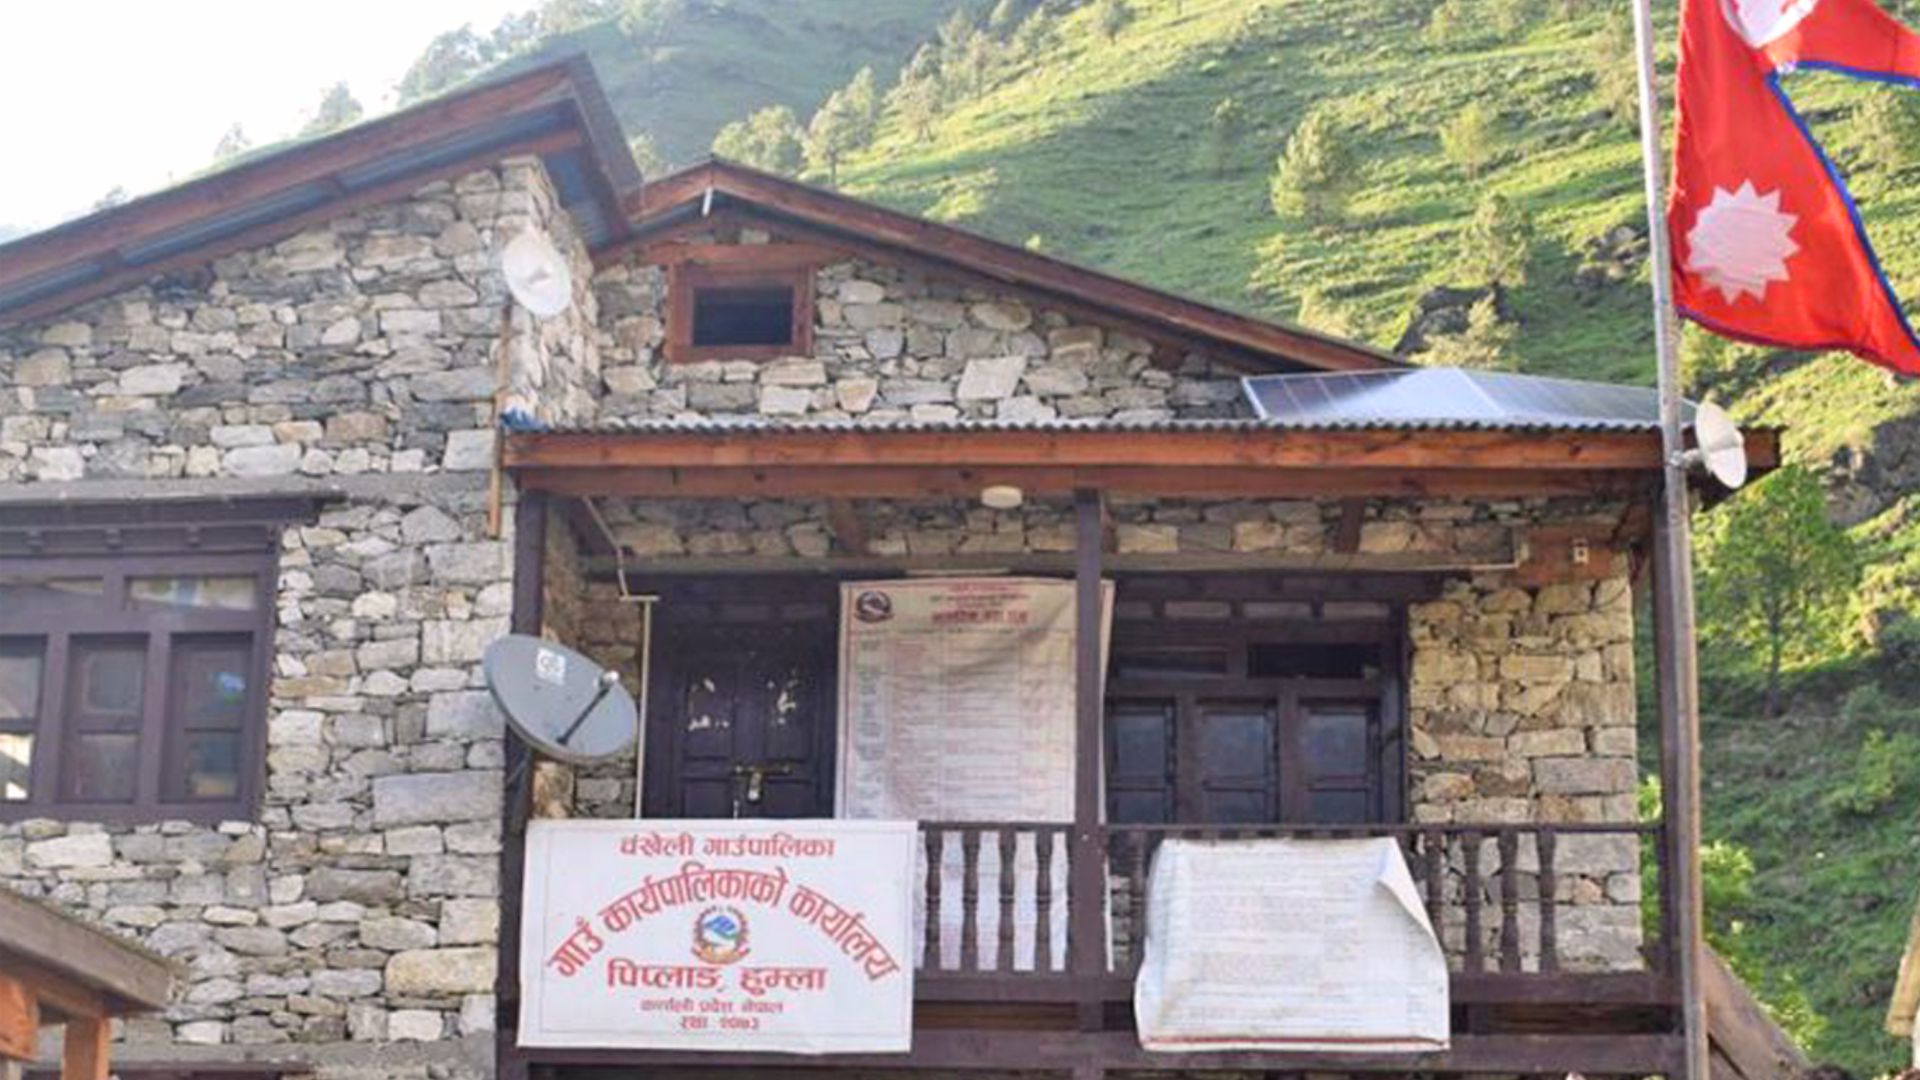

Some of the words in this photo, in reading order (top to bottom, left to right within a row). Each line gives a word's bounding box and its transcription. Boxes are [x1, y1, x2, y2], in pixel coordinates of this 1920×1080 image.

[597, 861, 789, 934] कार्यपालिकाको
[788, 884, 900, 982] कार्यालय
[738, 966, 828, 995] हुम्ला
